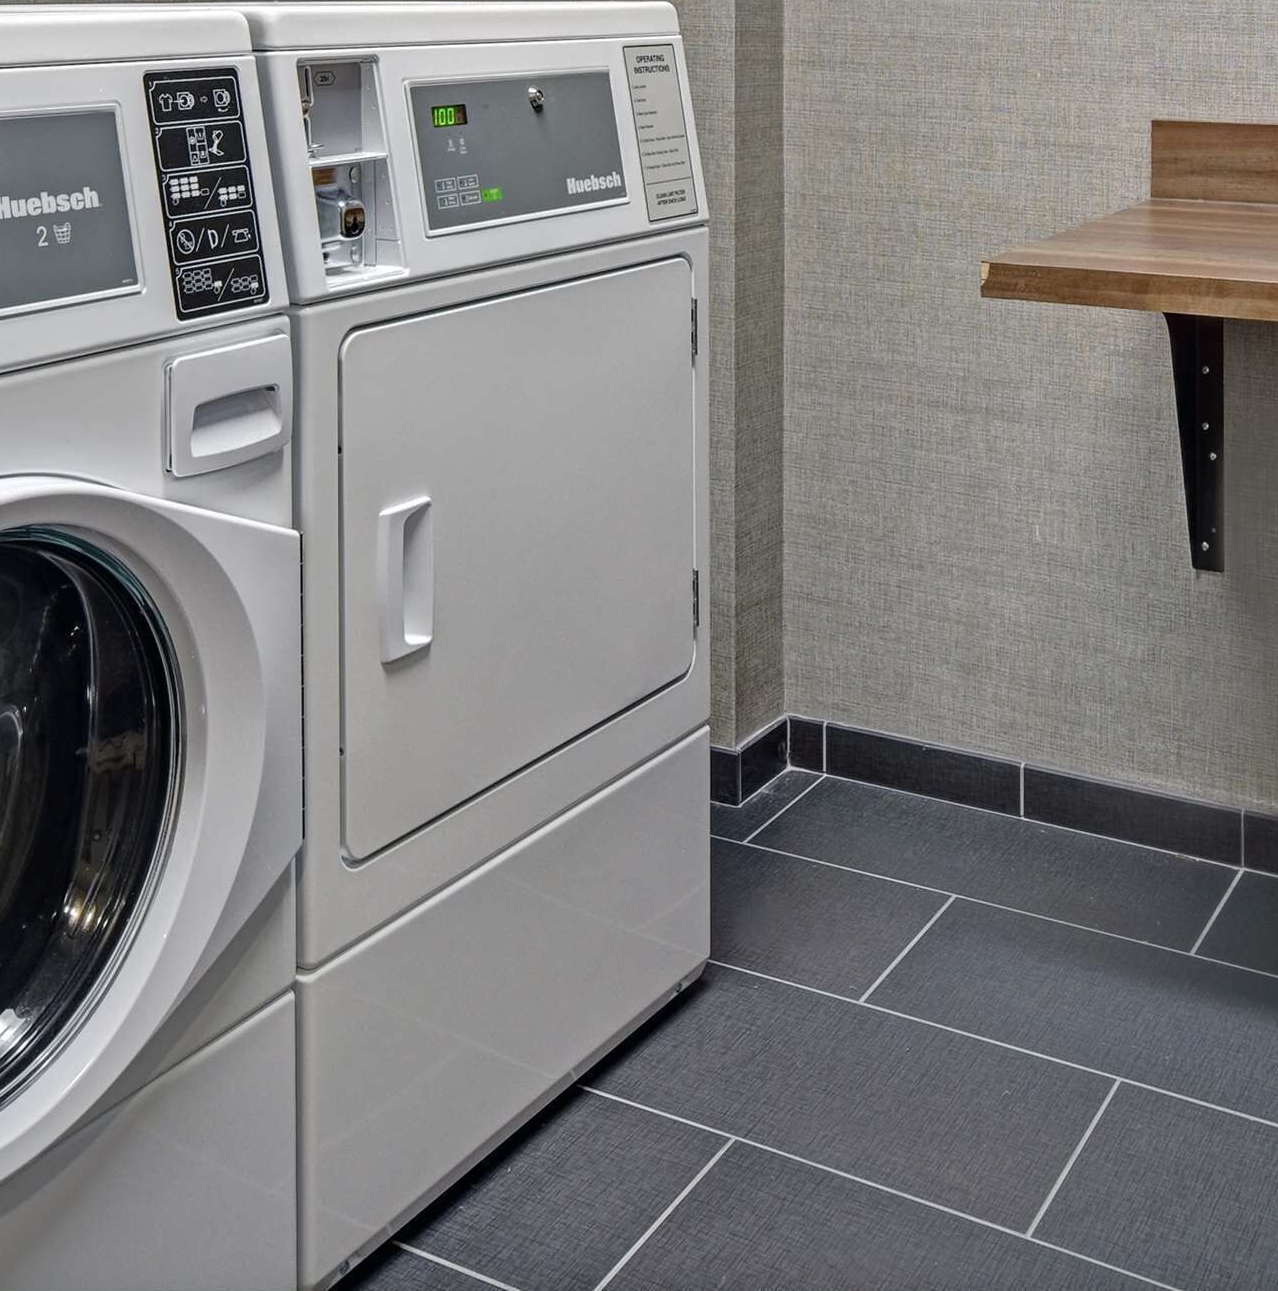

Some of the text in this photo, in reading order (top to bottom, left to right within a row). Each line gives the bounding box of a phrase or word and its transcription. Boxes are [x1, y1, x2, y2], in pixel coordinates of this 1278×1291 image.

[635, 54, 665, 63] OPERATING
[633, 64, 671, 75] INSTRUCTIONS
[566, 171, 622, 195] Huebsch
[36, 225, 49, 247] 2
